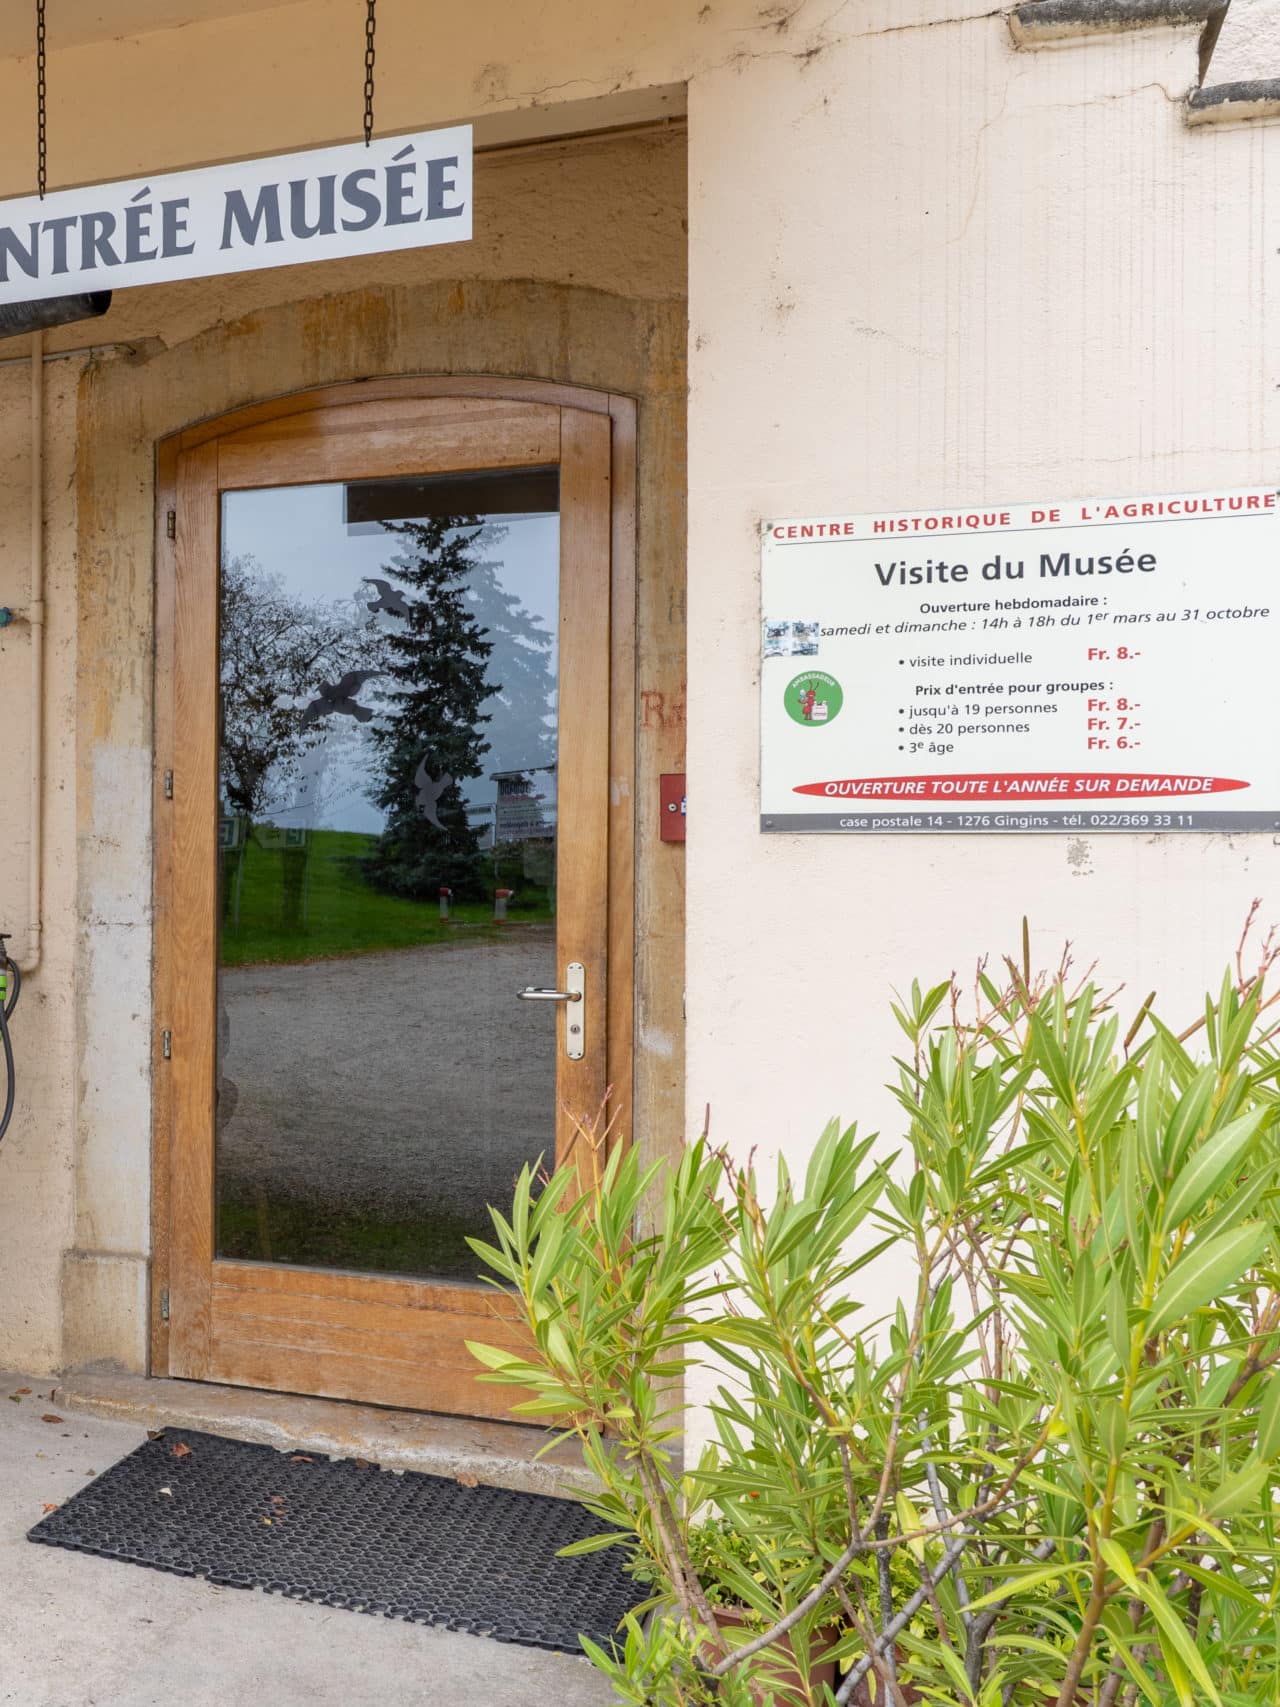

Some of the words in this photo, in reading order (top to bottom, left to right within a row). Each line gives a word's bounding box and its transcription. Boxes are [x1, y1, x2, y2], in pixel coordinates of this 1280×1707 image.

[220, 143, 466, 251] MUSÉE
[773, 522, 855, 539] CENTRE
[873, 512, 1011, 533] HISTORIQUE
[1031, 509, 1061, 523] DE
[1081, 493, 1276, 520] L'AGRICULTURE
[874, 559, 969, 588] Visite
[981, 554, 1025, 582] du
[1038, 548, 1158, 578] Musée
[920, 602, 991, 615] Ouverture
[995, 594, 1099, 611] hebdomadaire
[820, 622, 871, 637] samedi
[875, 623, 891, 635] et
[894, 619, 967, 634] dimanche
[982, 617, 1009, 630] 14h
[1013, 616, 1022, 629] à
[1028, 614, 1055, 628] 18h
[1060, 613, 1081, 627] du
[1113, 612, 1151, 624] mars
[1156, 611, 1176, 623] au
[1181, 609, 1200, 621] 31
[1206, 606, 1270, 620] octobre
[909, 655, 945, 668] visite
[949, 651, 1033, 667] individuelle
[1088, 647, 1110, 661] Fr.
[1117, 646, 1141, 660] 8.-
[915, 684, 941, 696] Prix
[945, 682, 1004, 695] d'entrée
[1008, 683, 1042, 696] pour
[1046, 681, 1105, 695] groupes
[908, 703, 959, 719] jusqu'à
[965, 704, 980, 715] 19
[985, 703, 1058, 717] personnes
[1088, 698, 1110, 712] Fr.
[1117, 697, 1141, 711] 8.-
[909, 723, 933, 735] dès
[936, 723, 954, 734] 20
[958, 722, 1030, 736] personnes
[1088, 717, 1110, 731] Fr.
[1117, 717, 1141, 731] 7.-
[928, 741, 954, 755] âge
[1088, 736, 1110, 750] Fr.
[1117, 736, 1141, 750] 6.-
[824, 781, 926, 795] OUVERTURE
[931, 780, 989, 794] TOUTE
[992, 777, 1069, 793] L'ANNÉE
[1074, 778, 1111, 792] SUR
[1115, 778, 1214, 792] DEMANDE
[839, 817, 868, 827] case
[872, 814, 922, 829] postale
[927, 815, 943, 826] 14
[957, 815, 990, 826] 1276
[994, 814, 1049, 828] Gingins
[1062, 814, 1086, 826] tél.
[1090, 814, 1149, 826] 022/369
[1153, 815, 1171, 826] 33
[1178, 815, 1193, 825] 11
